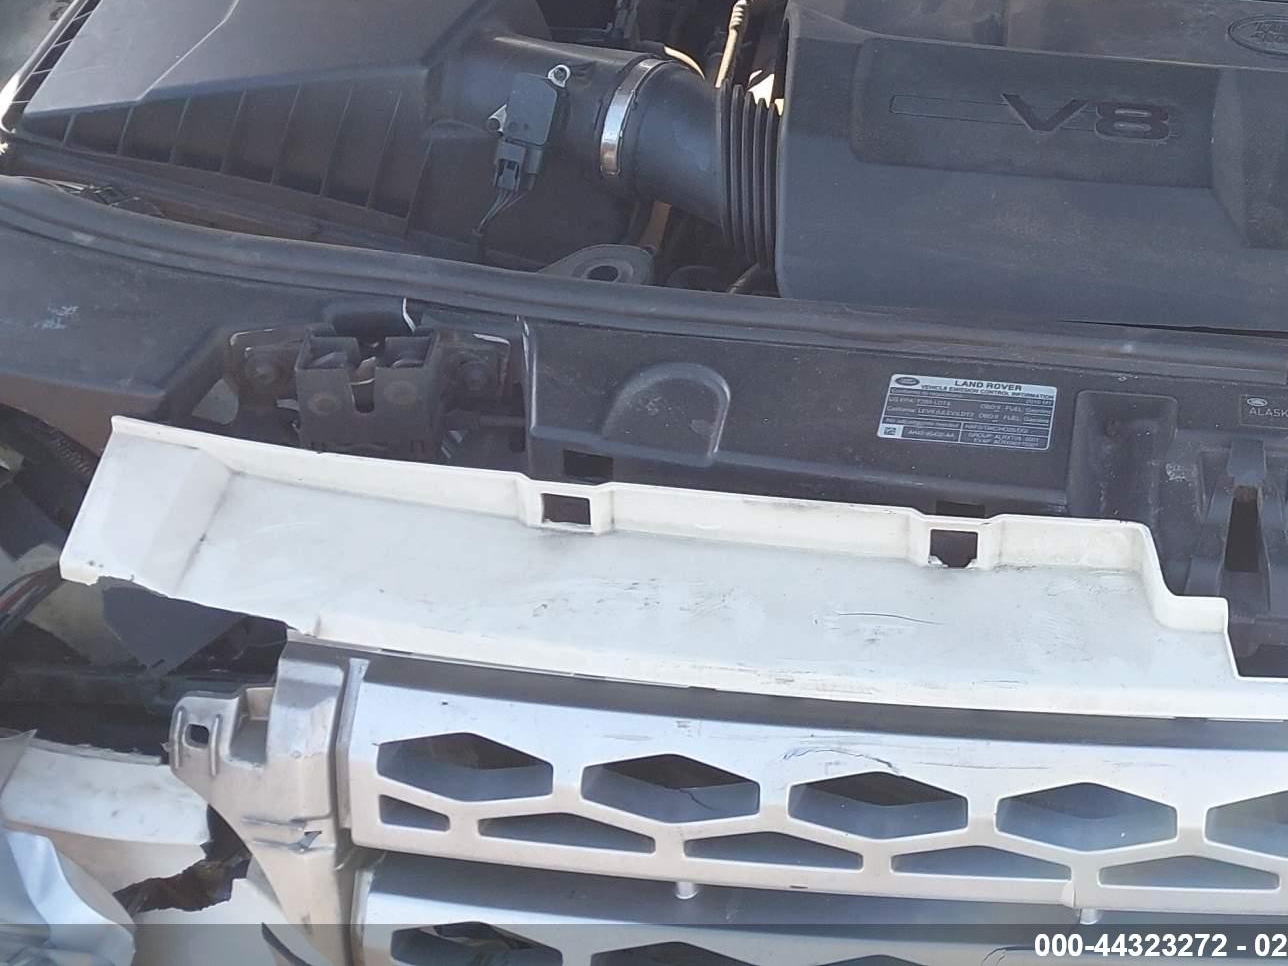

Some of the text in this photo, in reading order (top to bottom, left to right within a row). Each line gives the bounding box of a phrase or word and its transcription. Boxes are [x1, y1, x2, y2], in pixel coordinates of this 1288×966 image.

[1001, 93, 1171, 143] V8
[955, 380, 1023, 392] LAND ROVER
[980, 389, 1010, 397] CONTROL
